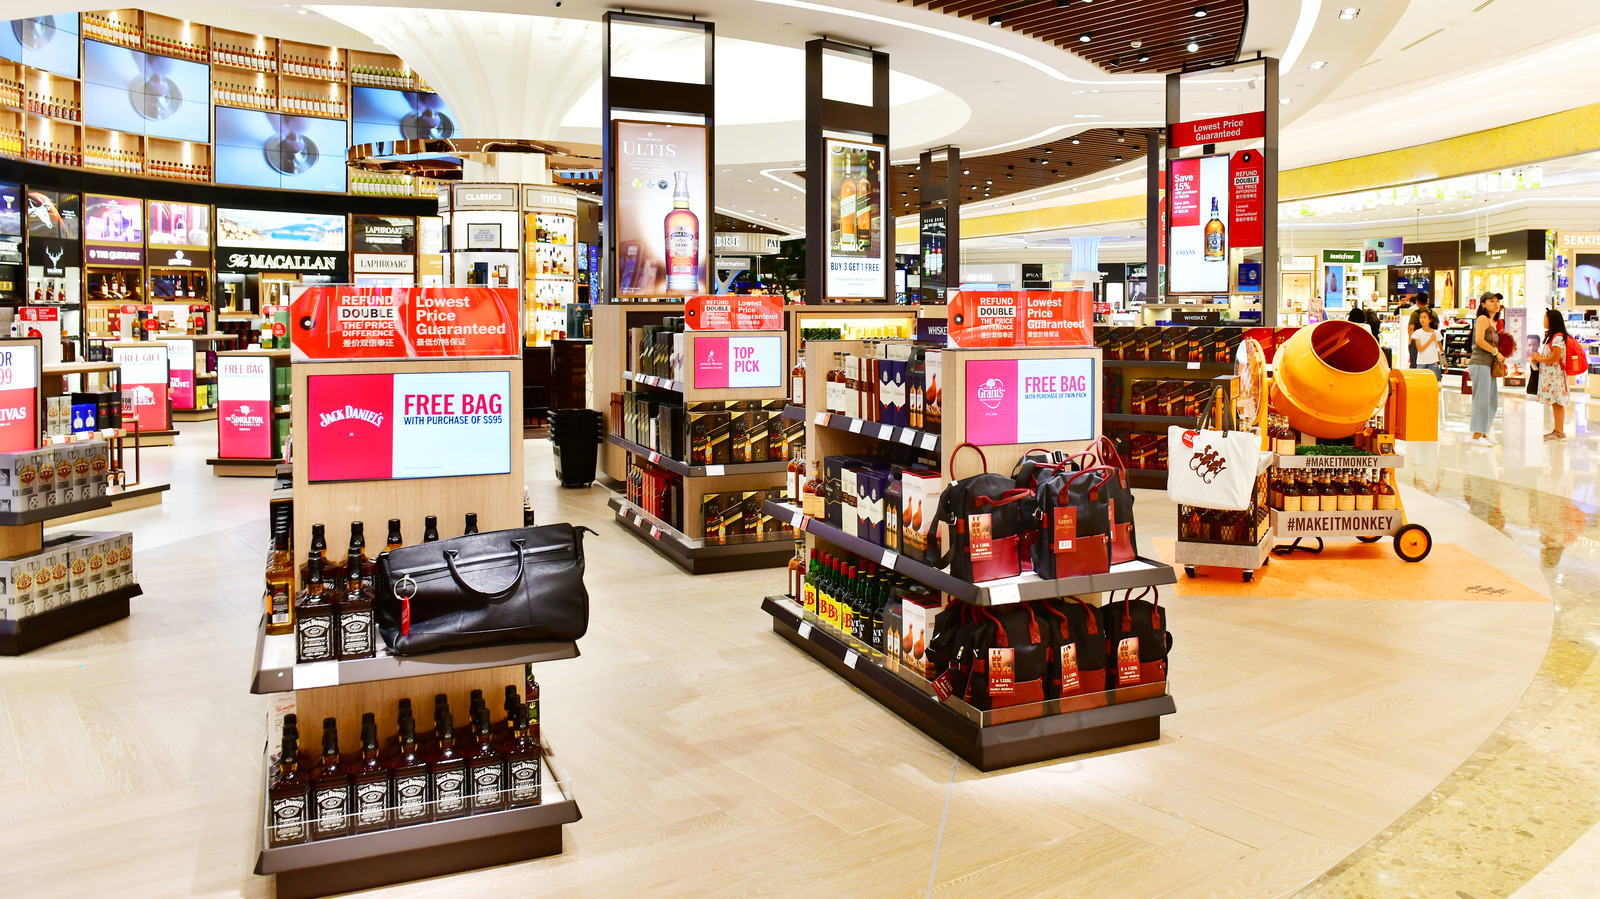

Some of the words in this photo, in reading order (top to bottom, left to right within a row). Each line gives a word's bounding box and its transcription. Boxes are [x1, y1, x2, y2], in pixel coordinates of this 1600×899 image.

[1194, 122, 1220, 132] Lowest
[1223, 120, 1244, 128] Price
[1195, 128, 1241, 141] Guaranteed
[623, 141, 676, 157] ULTIS
[1174, 174, 1193, 182] Save
[1174, 182, 1190, 191] 15%
[541, 195, 557, 204] THE
[365, 226, 403, 235] LAPHROAIG
[766, 238, 780, 248] PAY
[227, 254, 249, 269] The
[250, 254, 336, 270] MACALLAN
[360, 260, 408, 268] LAPHROAIG
[831, 262, 842, 271] BUY
[844, 263, 847, 271] 3
[849, 263, 859, 271] GET
[865, 263, 879, 272] FREE
[342, 296, 393, 306] REFUND
[416, 296, 470, 307] Lowest
[1027, 298, 1062, 307] Lowest
[342, 308, 394, 318] DOUBLE
[416, 310, 456, 321] Price
[980, 308, 1014, 316] DOUBLE
[1027, 309, 1053, 318] Price
[364, 321, 394, 329] PRICE
[416, 323, 506, 335] Guaranteed
[1027, 319, 1085, 329] Guaranteed
[928, 326, 947, 336] WHISKE
[734, 347, 754, 359] TOP
[225, 365, 242, 373] FREE
[247, 365, 263, 373] BAG
[735, 360, 759, 372] PICK
[1025, 377, 1056, 393] FREE
[1060, 376, 1086, 392] BAG
[978, 388, 1005, 398] Grant's
[404, 394, 455, 415] FREE
[462, 394, 502, 414] BAG
[231, 414, 264, 424] SINGLETON
[319, 410, 344, 427] JACK
[344, 405, 384, 427] DANIEL'S
[404, 417, 424, 425] WITH
[427, 416, 468, 425] PURCHASE
[471, 416, 481, 424] OF
[483, 415, 502, 424] S$95
[1306, 457, 1378, 467] #MAKEITMONKEY
[1287, 516, 1393, 532] #MAKEITMONKEY
